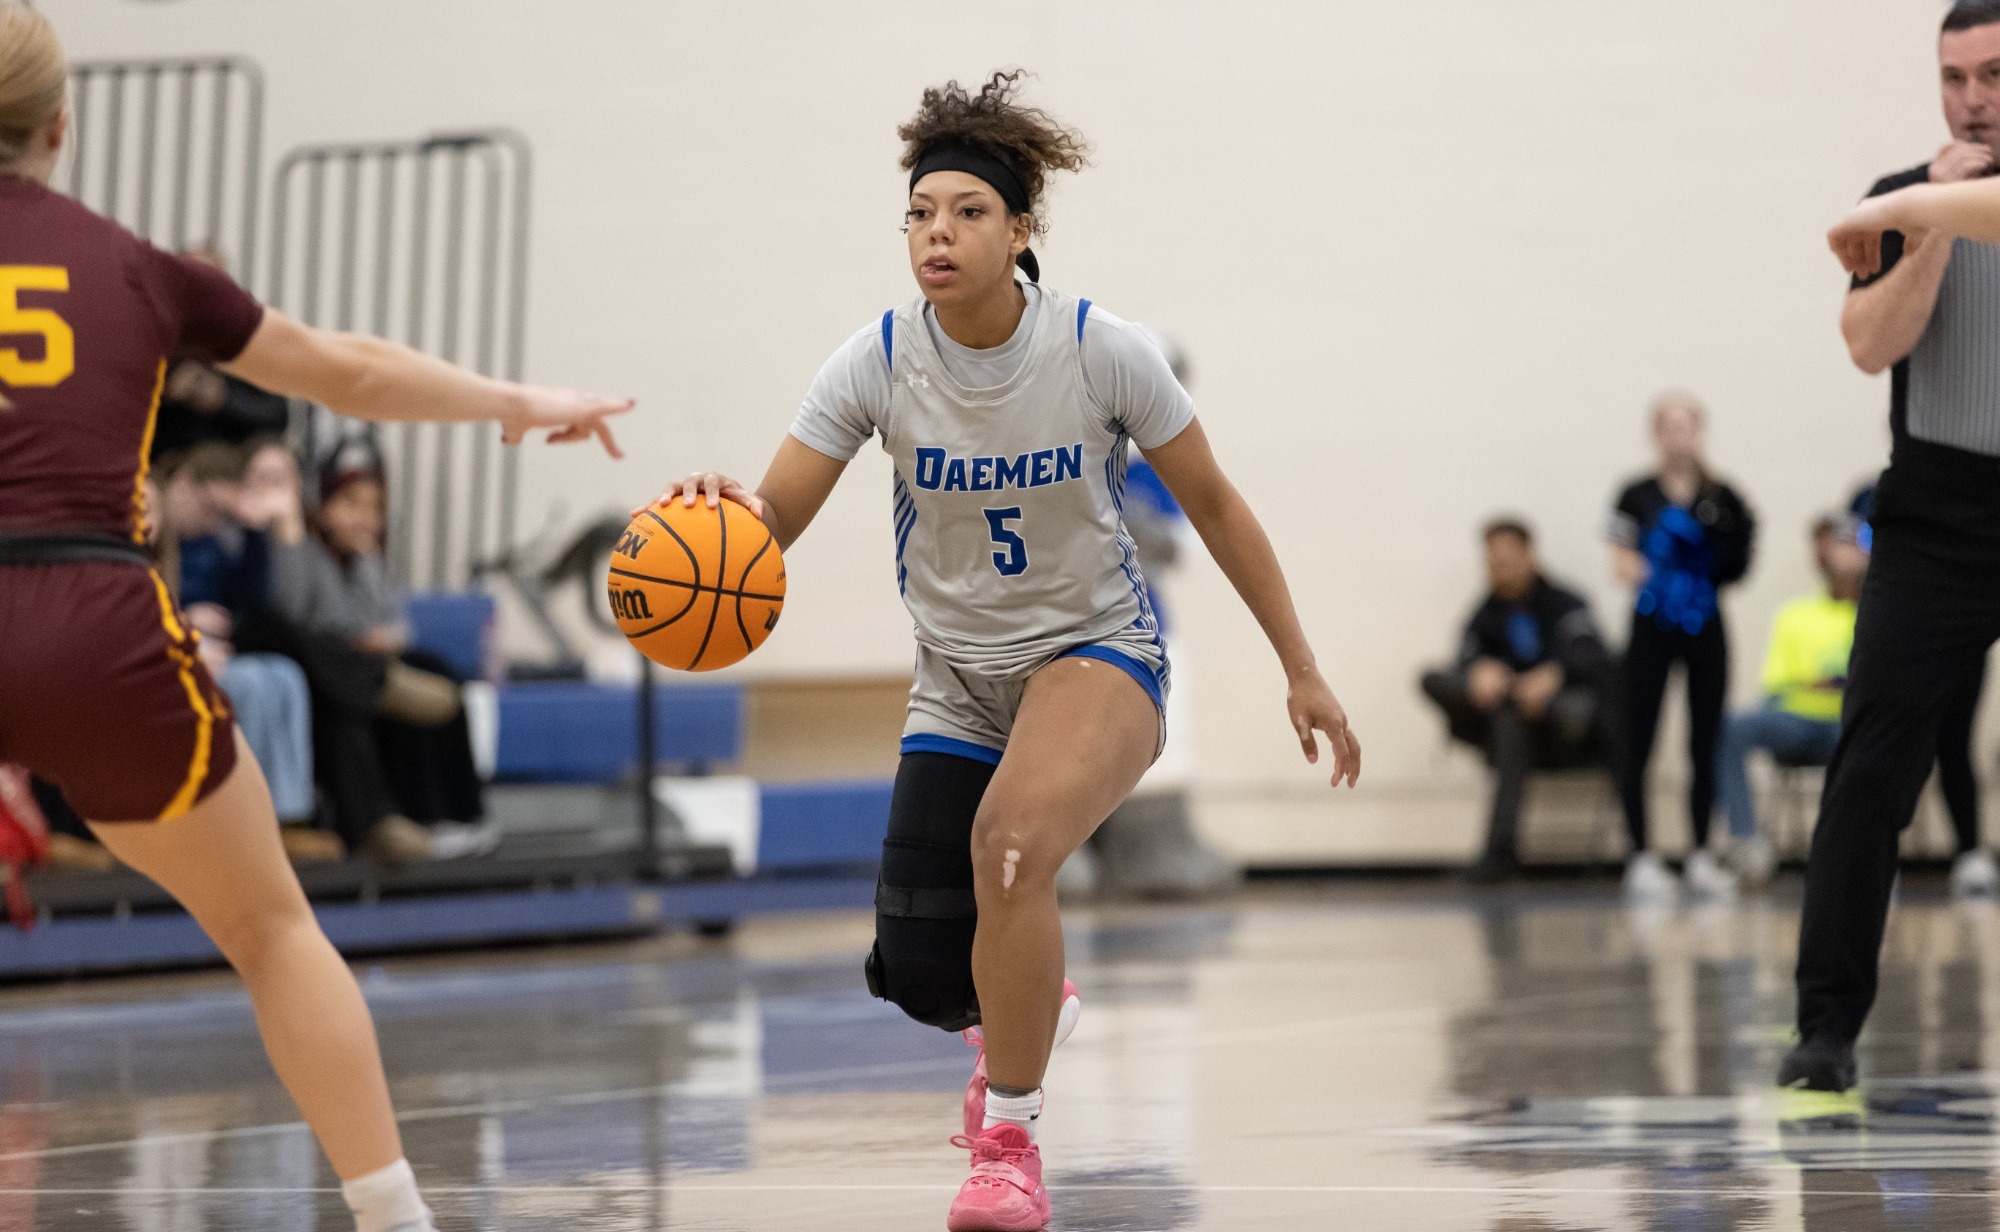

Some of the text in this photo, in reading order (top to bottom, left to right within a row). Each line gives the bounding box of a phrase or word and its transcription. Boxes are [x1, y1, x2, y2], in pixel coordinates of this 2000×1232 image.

[0, 263, 75, 388] 5
[915, 442, 1083, 491] DAEMEN
[982, 506, 1029, 577] 5
